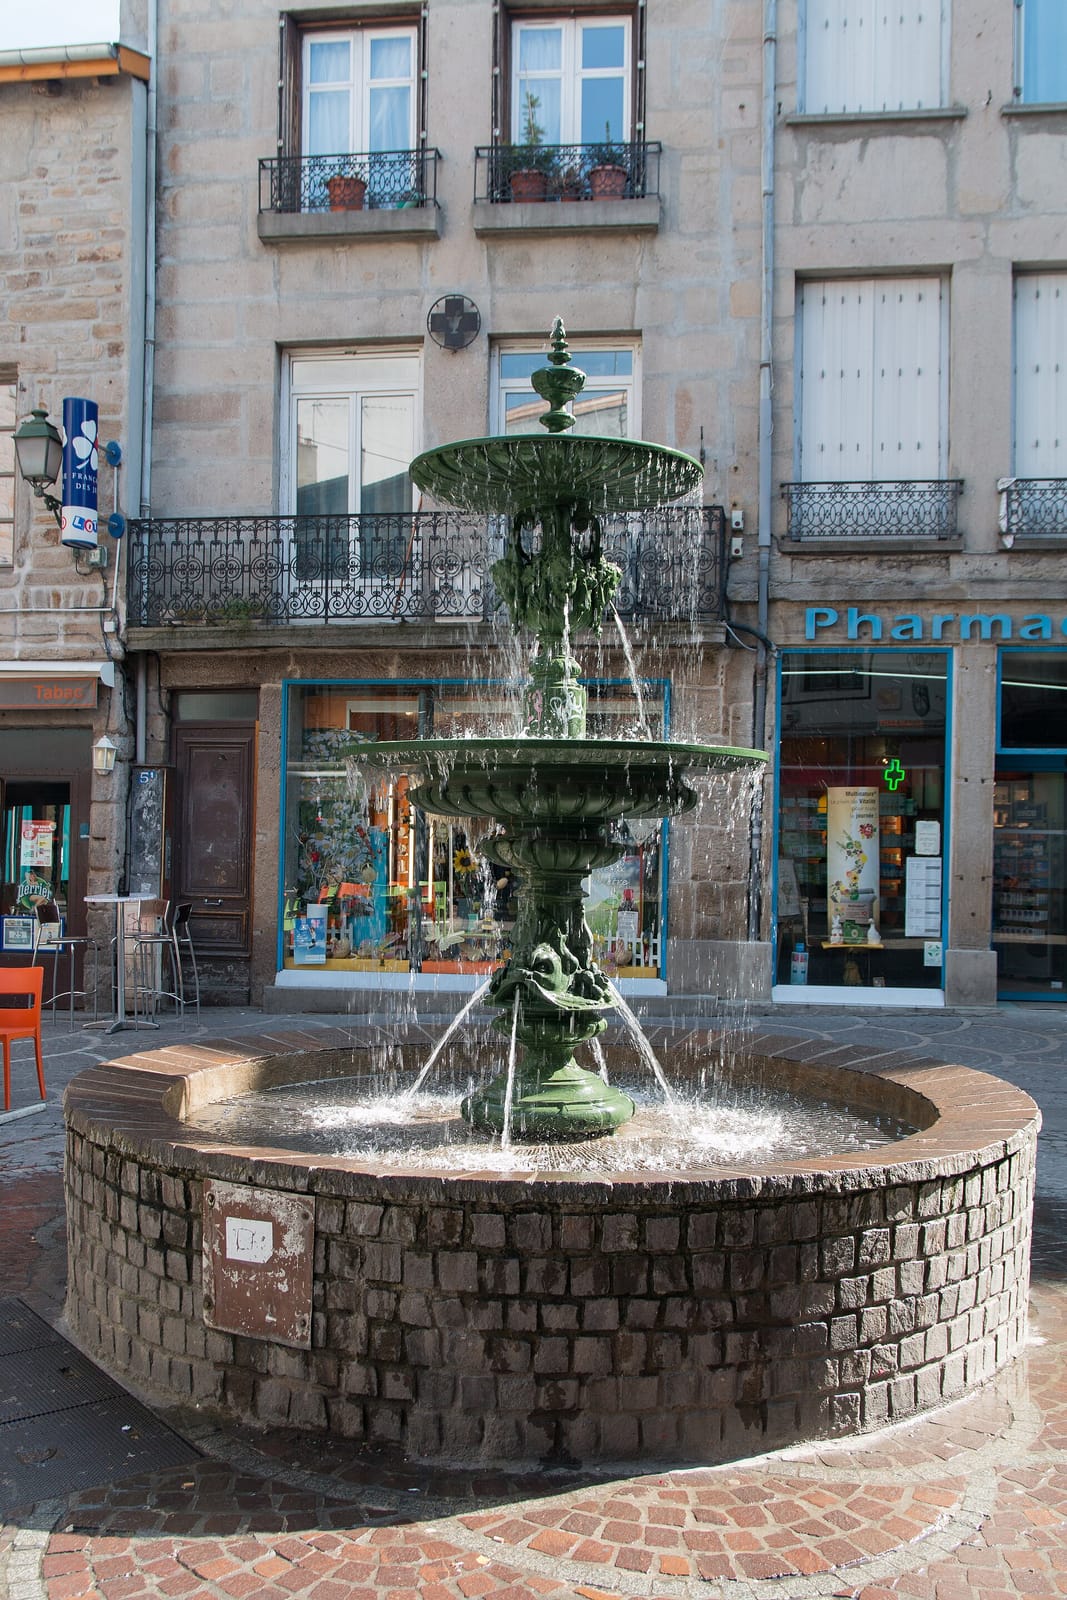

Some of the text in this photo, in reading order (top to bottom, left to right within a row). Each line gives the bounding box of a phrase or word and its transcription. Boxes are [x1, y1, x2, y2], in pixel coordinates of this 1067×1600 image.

[76, 482, 90, 491] DES
[805, 607, 1067, 640] Pharma
[33, 684, 84, 700] Tabac
